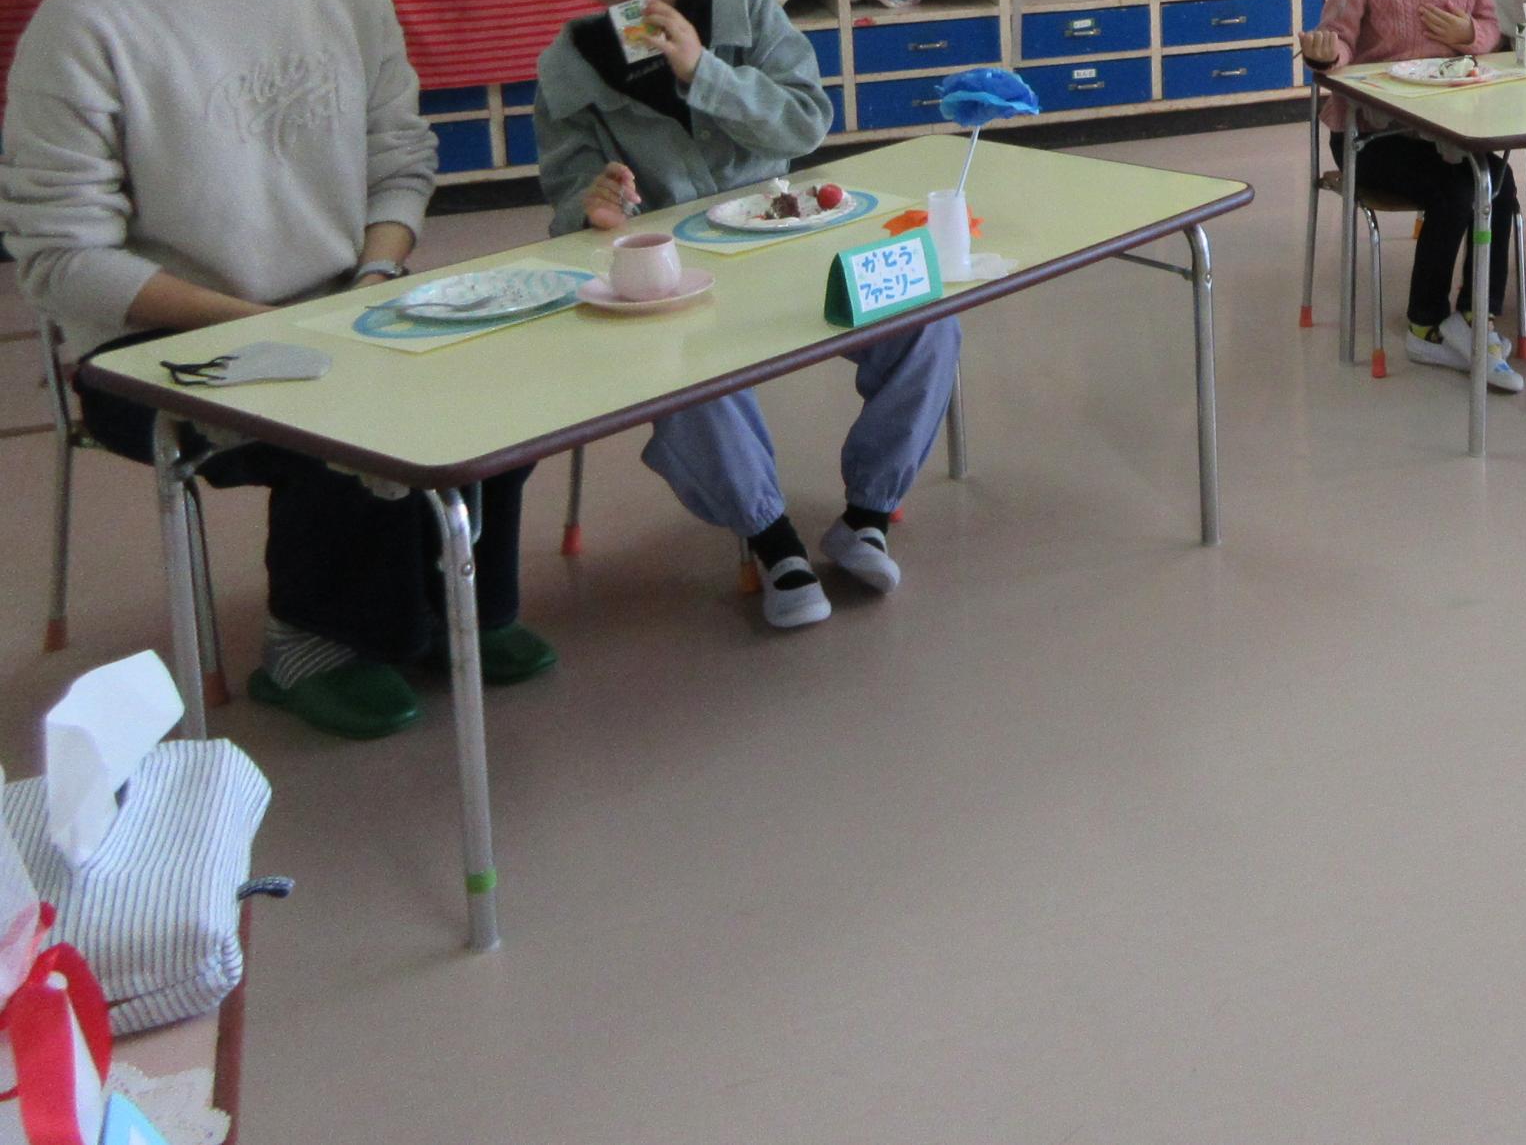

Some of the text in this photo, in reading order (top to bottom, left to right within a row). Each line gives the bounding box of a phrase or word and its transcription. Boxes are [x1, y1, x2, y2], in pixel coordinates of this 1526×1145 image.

[861, 245, 913, 273] かとう
[860, 273, 925, 304] ファミリー
